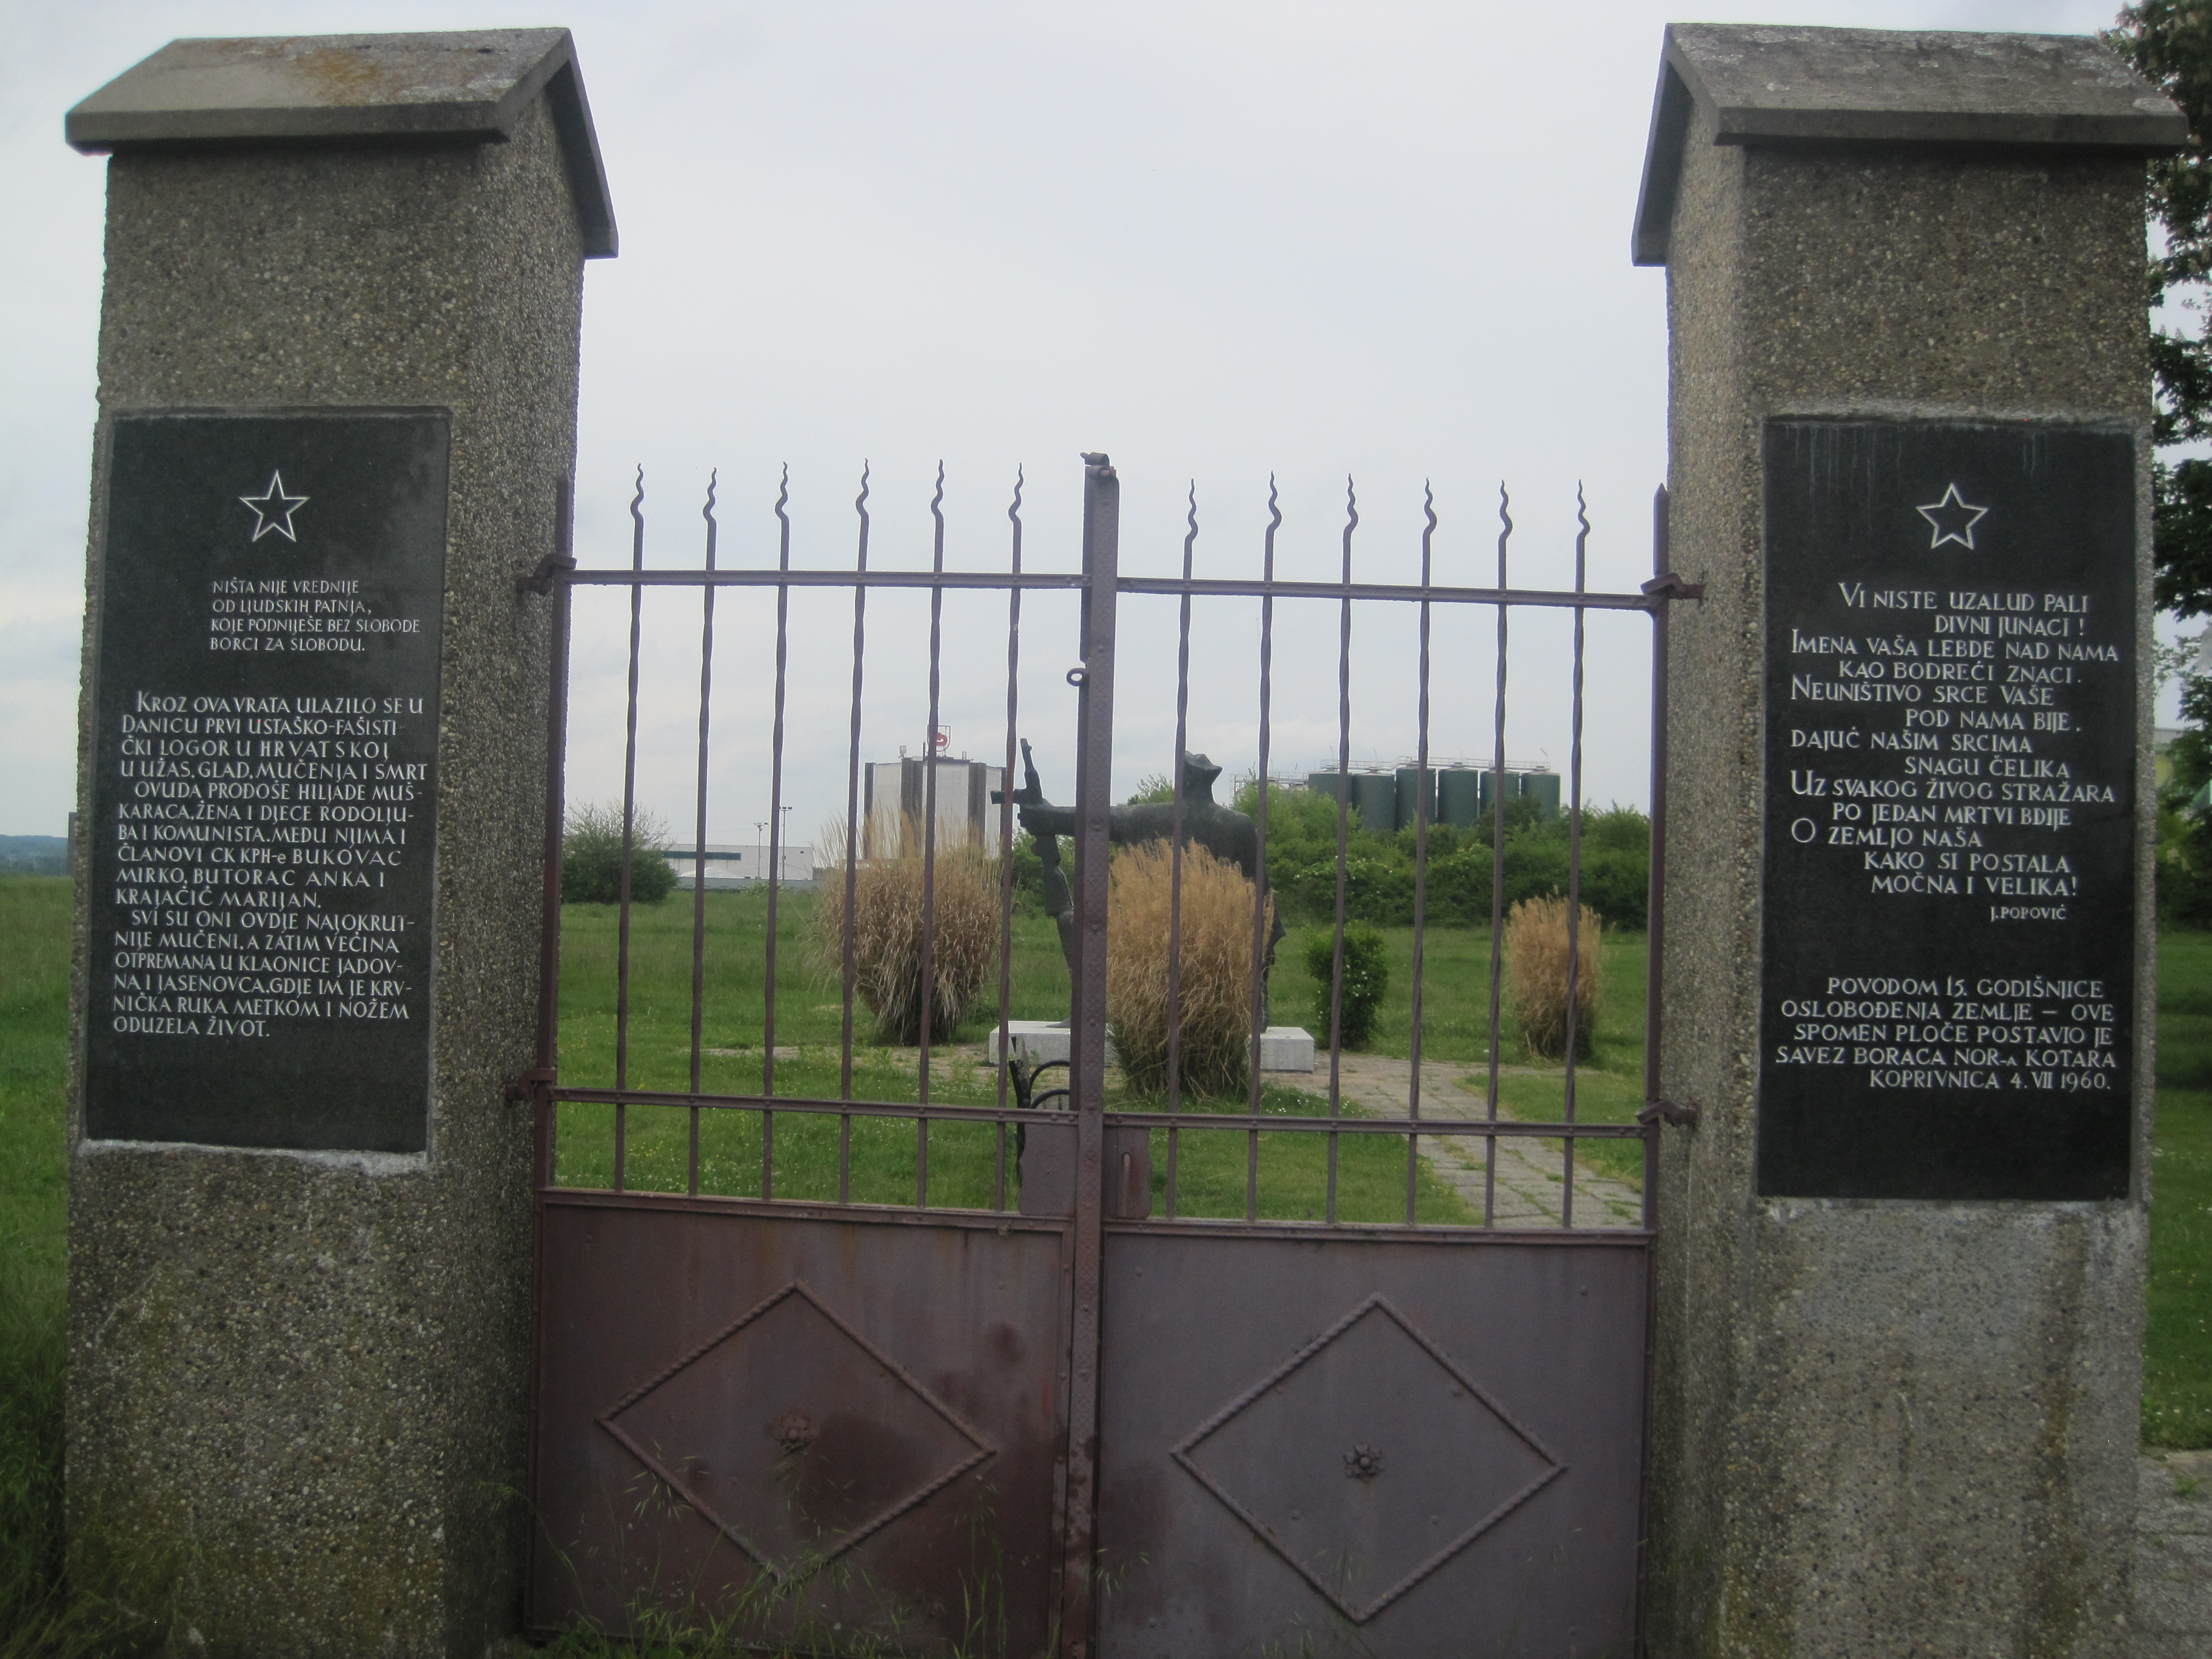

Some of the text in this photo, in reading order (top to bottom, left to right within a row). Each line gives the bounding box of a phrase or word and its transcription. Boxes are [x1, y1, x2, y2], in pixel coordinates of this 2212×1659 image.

[213, 577, 358, 596] NIŠTA NIJE VREDNIJE
[213, 600, 235, 612] OD
[241, 600, 308, 615] LJUDSKIH
[1874, 591, 1937, 609] NISTE
[1949, 592, 2034, 611] UZALUD
[2044, 594, 2088, 612] PALI
[212, 615, 420, 634] KOJE PODNIJEŠE BEZ SLOBODE
[1934, 615, 1989, 634] DIVNI
[210, 637, 364, 651] BORCI ZA SLOBODU.
[1866, 635, 1918, 655] VAŠA
[1928, 640, 1994, 658] LEBDE
[2005, 642, 2049, 659] NAD
[2059, 644, 2119, 661] NAMA
[1839, 661, 1885, 678] KAO
[1894, 661, 1993, 680] BODREĆI
[193, 697, 231, 712] OVA
[233, 697, 290, 712] VRATA
[297, 697, 376, 713] ULAZILO
[384, 698, 403, 713] SE
[409, 699, 423, 714] U
[1933, 686, 1987, 703] SRCE
[2000, 684, 2054, 706] VAŠE
[206, 718, 240, 734] PRVI
[1906, 709, 1949, 727] POD
[1960, 711, 2025, 729] NAMA
[121, 734, 151, 755] ČKI
[161, 740, 229, 756] LOGOR
[237, 740, 250, 756] U
[1871, 729, 1939, 750] NAŠIM
[1951, 734, 2033, 752] SRCIMA
[121, 760, 133, 777] U
[363, 764, 367, 779] I
[376, 764, 427, 780] SMRT
[1905, 755, 2070, 778] SNAGU ČELIKA
[135, 780, 421, 803] OVUDA PROĐOŠE HILJADE MUŠ-
[1832, 779, 1917, 797] SVAKOG
[1926, 778, 1992, 799] ŽIVOG
[2002, 781, 2115, 802] STRAŽARA
[248, 805, 252, 820] I
[261, 805, 311, 825] DJECE
[1833, 803, 2071, 831] PO JEDAN MRTVI BDIJE
[118, 824, 138, 840] BA
[142, 825, 147, 840] I
[335, 828, 395, 848] NJIMA
[401, 829, 405, 844] I
[1791, 817, 1982, 848] O ZEMLJO NAŠA
[118, 842, 202, 862] ČLANOVI
[211, 848, 235, 862] CK
[292, 849, 401, 865] BUKOVAC
[1864, 851, 2070, 873] KAKO SI POSTALA
[193, 868, 295, 885] BUTORAC
[306, 871, 370, 886] ANKA
[380, 872, 384, 887] I
[1967, 876, 1972, 894] I
[1985, 876, 2077, 896] VELIKA!
[220, 891, 321, 911] MARIJAN.
[132, 910, 414, 933] SVI SU ONI OVDJE NAJOKRUT-
[115, 931, 152, 950] NIJE
[247, 935, 260, 950] A
[266, 935, 320, 951] ZATIM
[115, 952, 403, 977] OTPREMANA U KLAONICE JADOV-
[115, 974, 140, 990] NA
[146, 974, 150, 990] I
[319, 979, 343, 994] IM
[349, 980, 365, 999] JE
[370, 980, 412, 996] KRV-
[1826, 976, 2103, 999] POVODOM 15. GODIŠNJICE
[113, 992, 409, 1019] NIČKA RUKA METKOM I NOŽEM
[1781, 1000, 1941, 1021] OSLOBOĐENJA
[1952, 1002, 2032, 1022] ZEMLJE
[2071, 1004, 2114, 1022] OVE
[113, 1016, 269, 1036] ODUZELA ŽIVOT.
[1794, 1022, 2113, 1048] SPOMEN PLOČE POSTAVIO JE
[1776, 1046, 1845, 1064] SAVEZ
[1854, 1047, 1946, 1065] BORACA
[2025, 1050, 2116, 1068] KOTARA
[1870, 1070, 2110, 1092] KOPRIVNICA 4. VII 1960.
